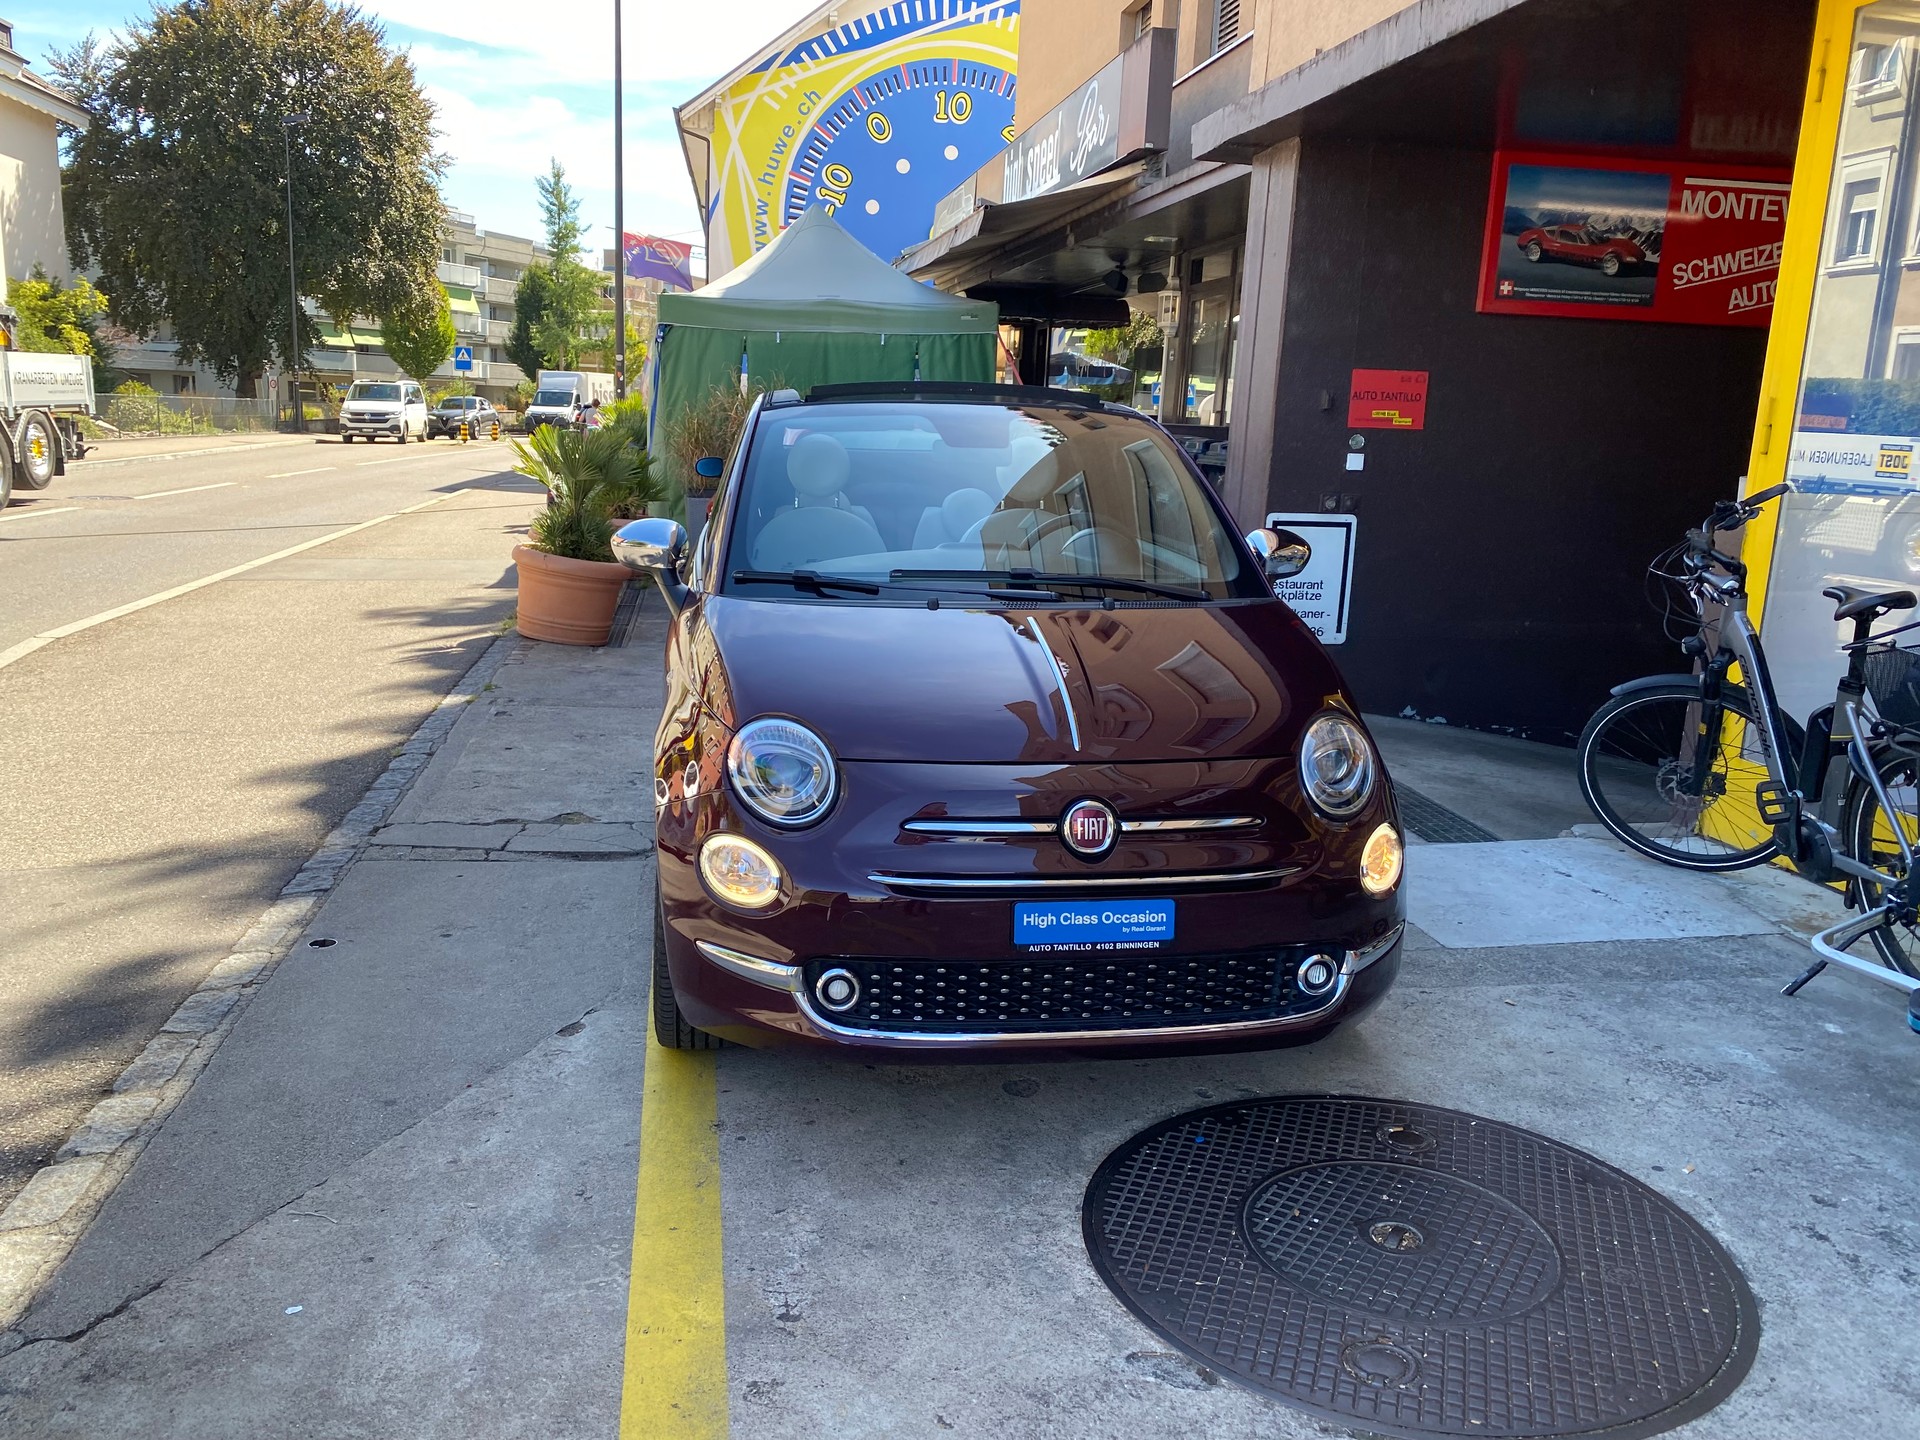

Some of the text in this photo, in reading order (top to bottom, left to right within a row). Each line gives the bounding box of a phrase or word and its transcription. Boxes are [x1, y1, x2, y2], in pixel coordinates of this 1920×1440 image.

[934, 90, 973, 123] 10
[866, 111, 891, 142] 0
[1026, 110, 1062, 195] speed
[1070, 80, 1109, 175] Bar
[1352, 391, 1421, 402] AUTO TANTILLO
[1076, 817, 1106, 840] FIAT
[1023, 910, 1166, 928] High Class Occasion
[1053, 943, 1092, 951] TANTILLO
[1096, 942, 1114, 950] 4102
[1116, 941, 1160, 950] BINNINGEN
